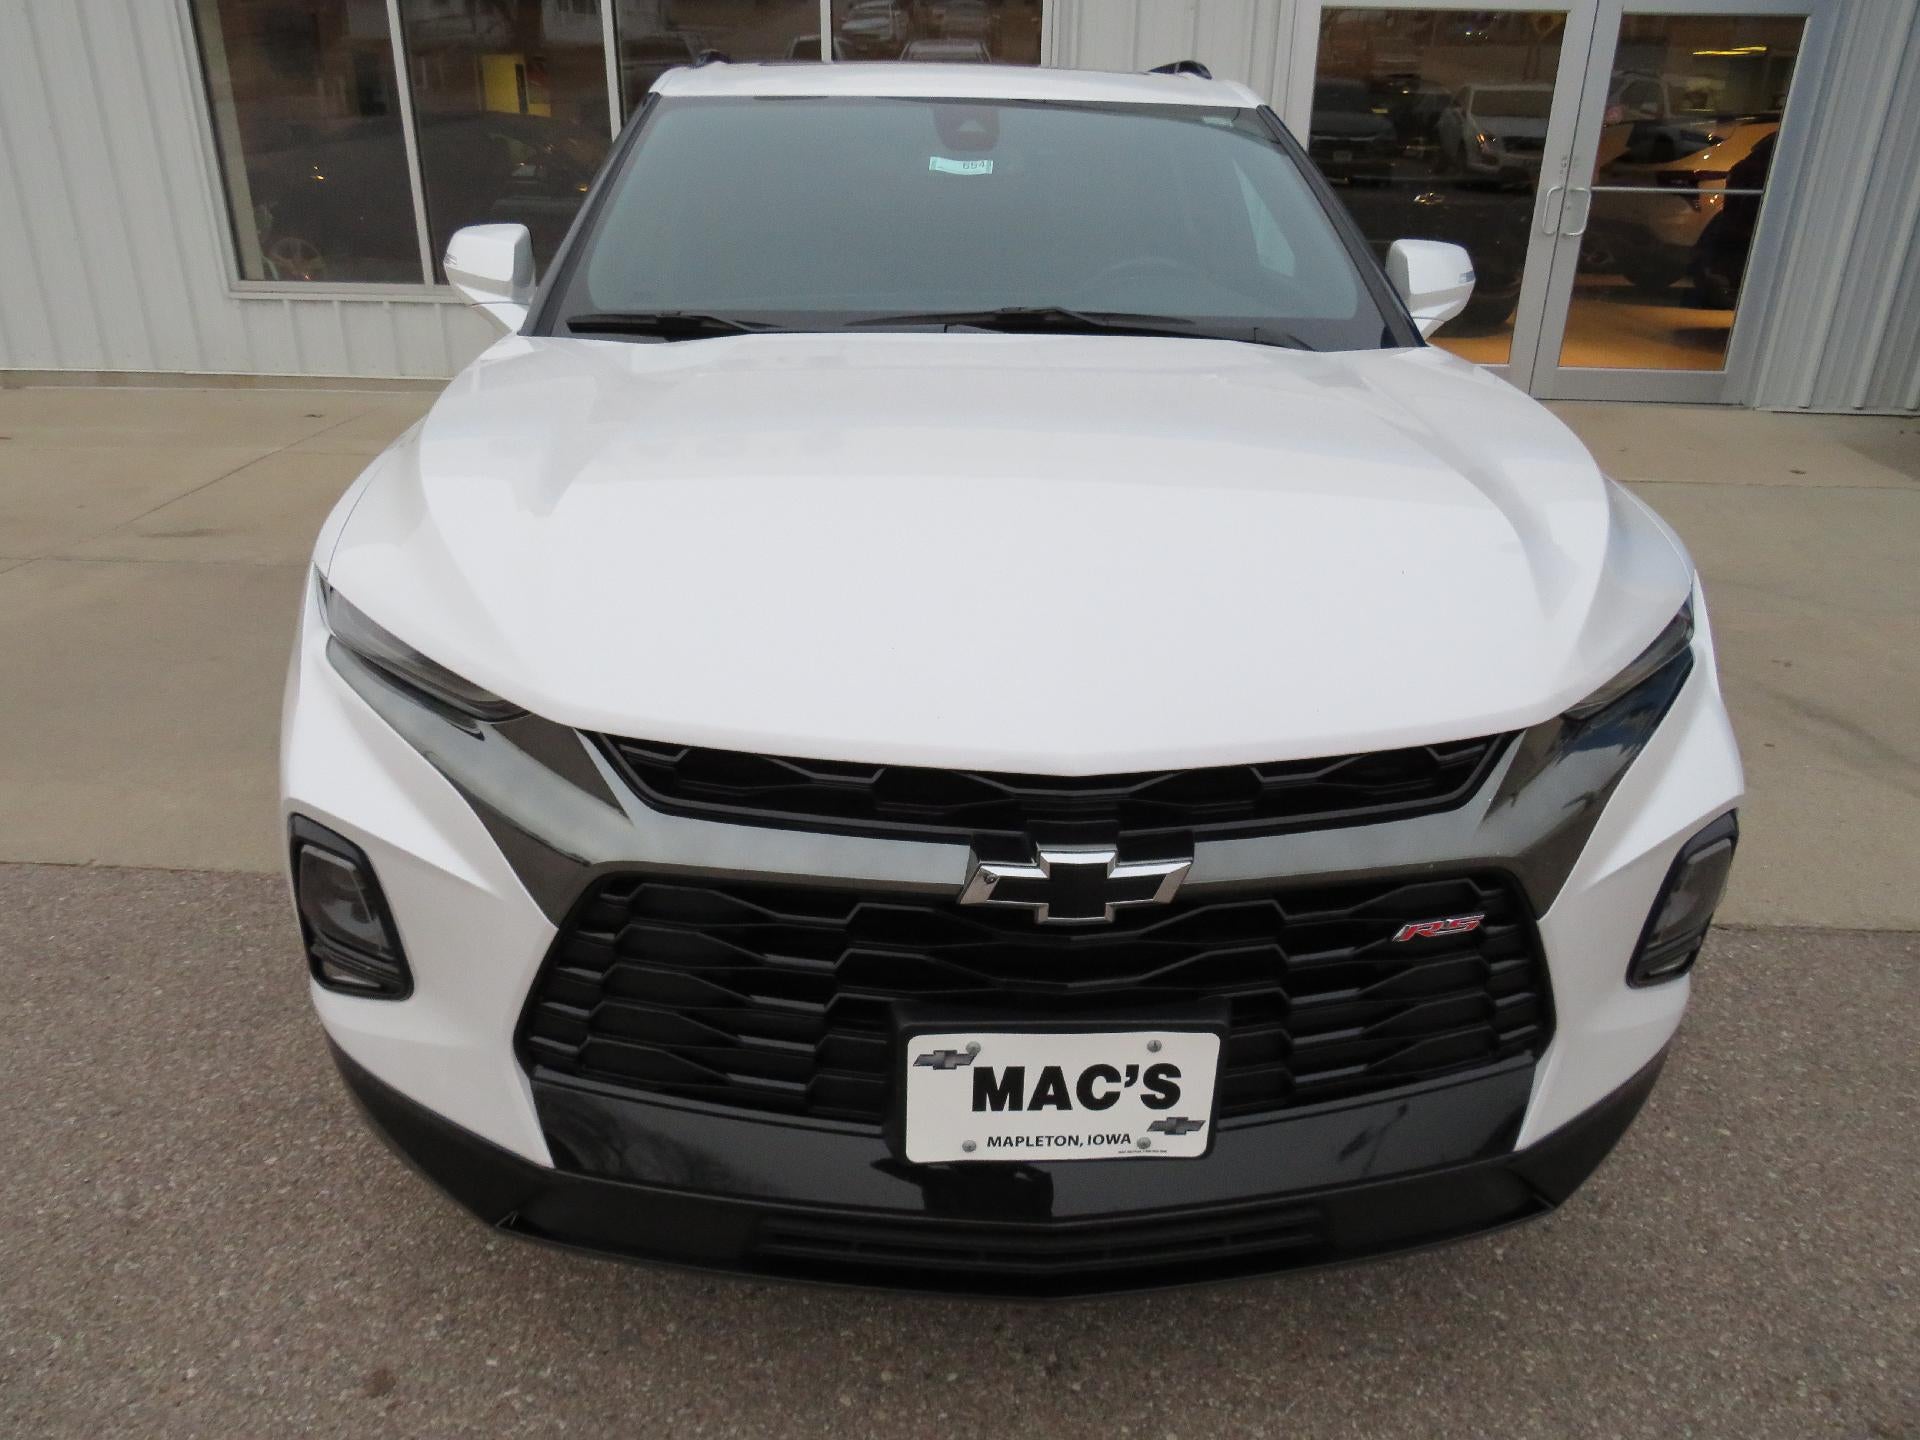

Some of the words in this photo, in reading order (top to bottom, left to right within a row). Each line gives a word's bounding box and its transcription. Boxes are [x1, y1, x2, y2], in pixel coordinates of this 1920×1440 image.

[1392, 914, 1485, 942] RS
[972, 1063, 1182, 1111] MAC'S
[987, 1135, 1084, 1148] MAPLETON,
[1087, 1133, 1132, 1146] IOWA
